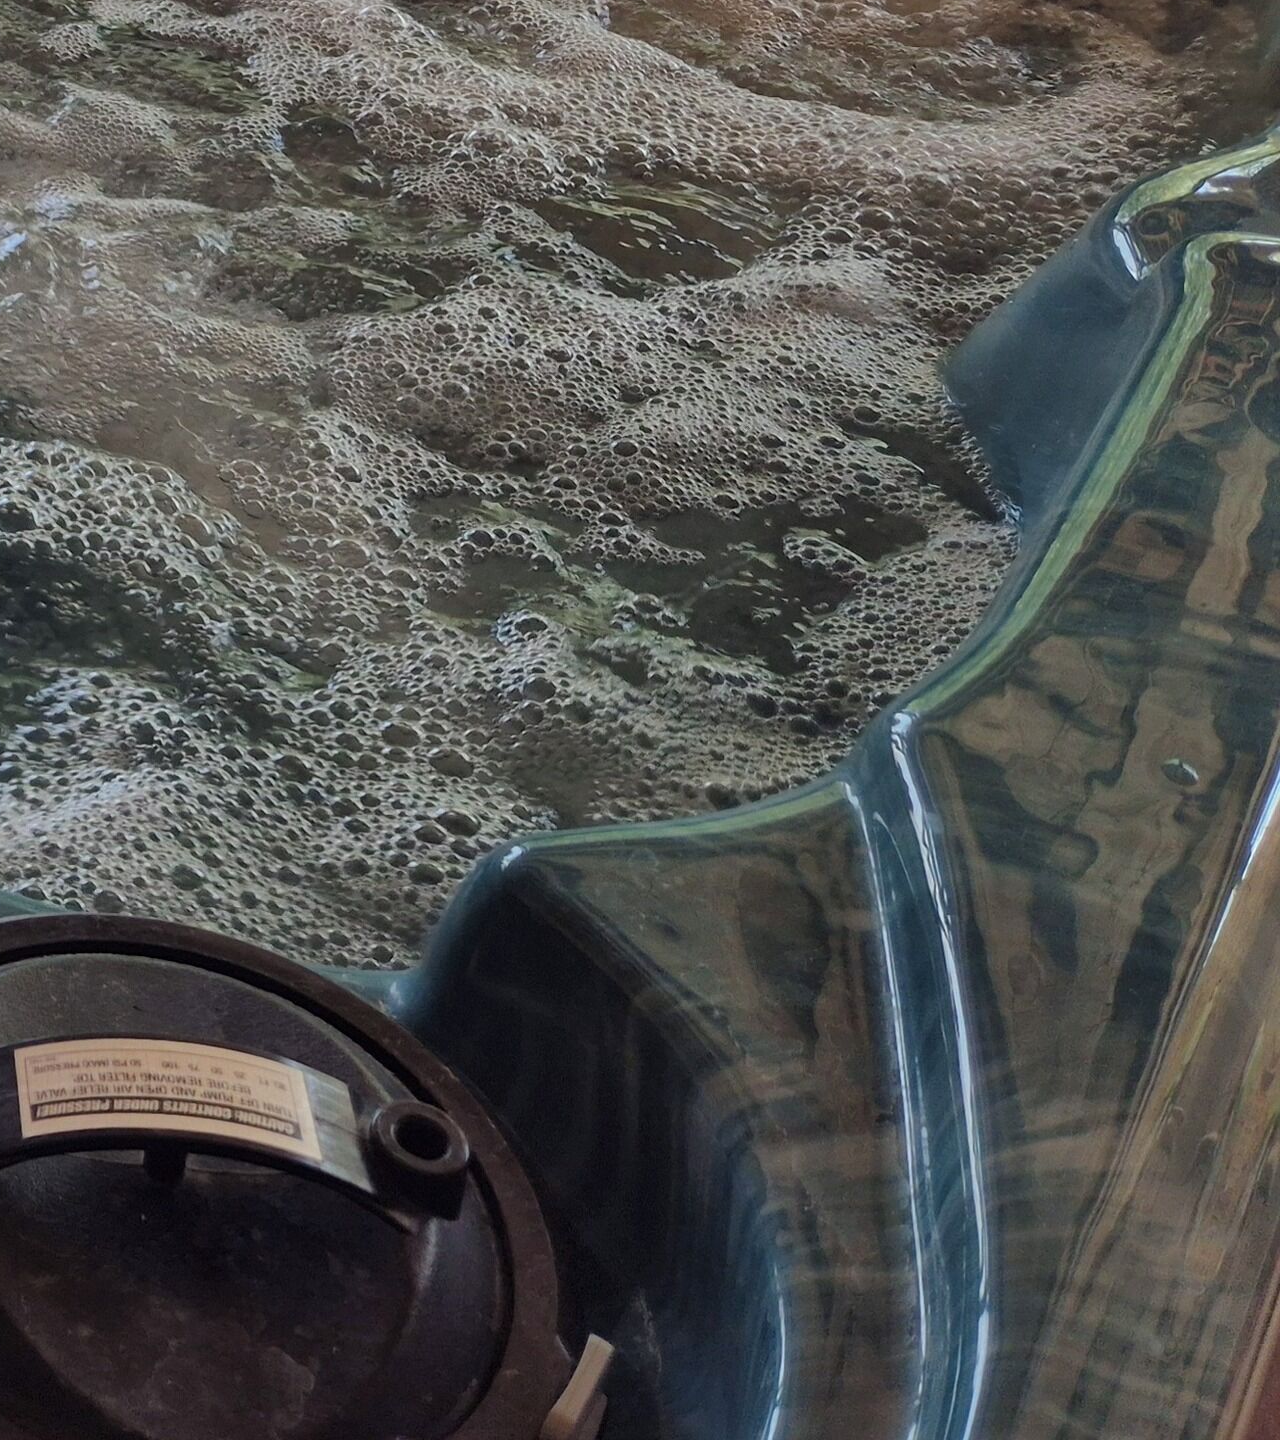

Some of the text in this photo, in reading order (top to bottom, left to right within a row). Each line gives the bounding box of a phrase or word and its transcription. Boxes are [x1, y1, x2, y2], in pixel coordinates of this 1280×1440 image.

[98, 1072, 136, 1083] FILTER
[140, 1072, 202, 1086] REMOVING
[71, 1085, 108, 1095] RELIEF
[113, 1085, 132, 1094] AIR
[135, 1085, 167, 1095] OPEN
[171, 1086, 195, 1097] AND
[207, 1079, 251, 1095] BEFORE
[35, 1088, 66, 1100] VALVE
[200, 1091, 233, 1103] PUMP
[36, 1099, 294, 1135] CAUTION: CONTENTS UNDER PRESSURE!
